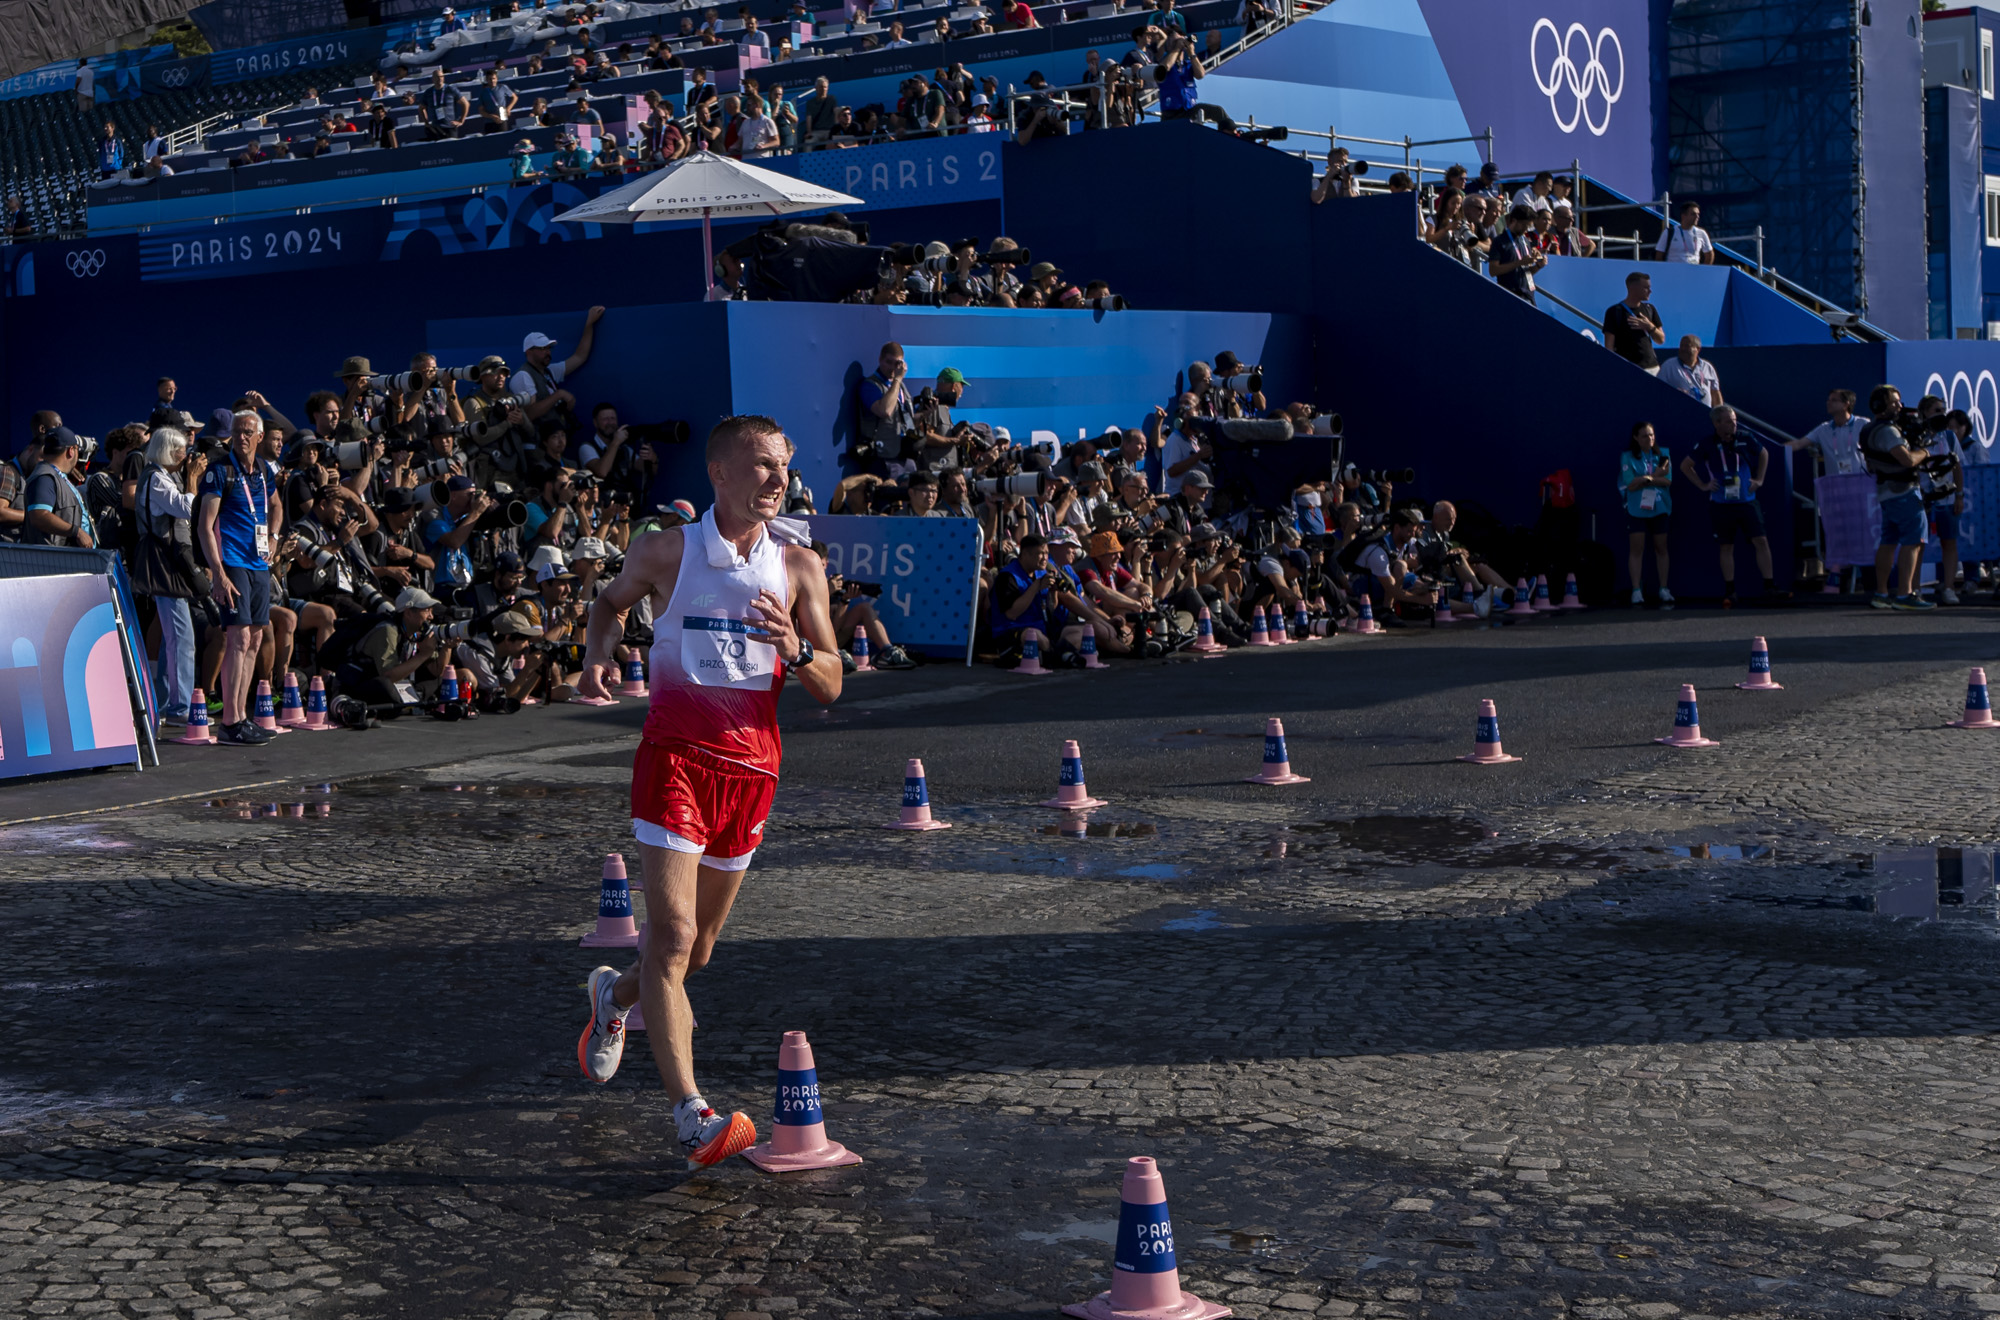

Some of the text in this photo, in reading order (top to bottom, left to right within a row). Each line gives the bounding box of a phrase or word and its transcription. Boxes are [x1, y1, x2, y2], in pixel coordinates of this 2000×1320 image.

[298, 41, 348, 65] 2024
[657, 193, 760, 204] PARIS 2024
[264, 226, 341, 260] 2024
[691, 593, 718, 608] 4F
[717, 638, 746, 659] 70
[699, 659, 760, 672] BRZOZOWSKI
[600, 899, 627, 909] 2024
[783, 1098, 821, 1112] 2024
[1139, 1237, 1174, 1256] 202
